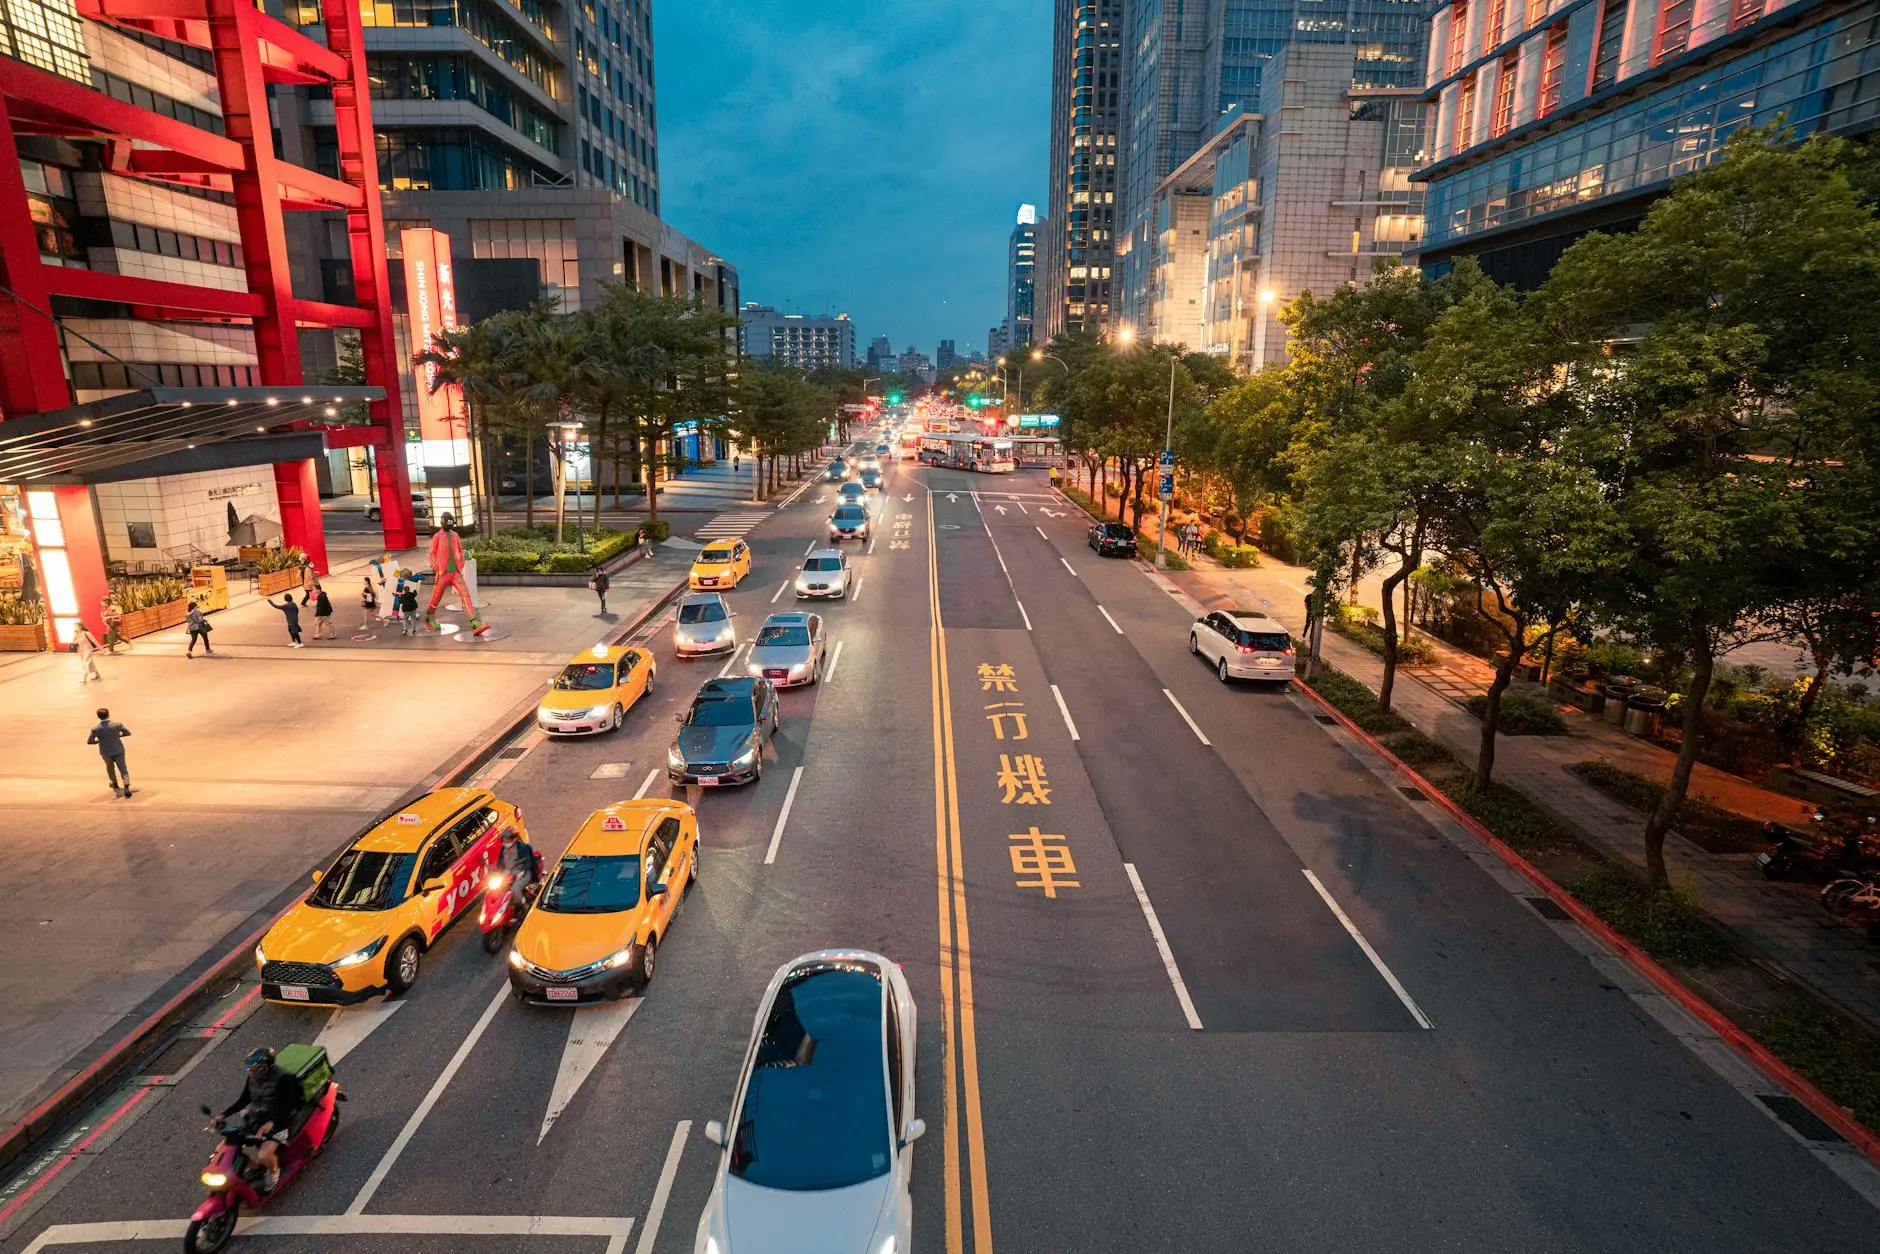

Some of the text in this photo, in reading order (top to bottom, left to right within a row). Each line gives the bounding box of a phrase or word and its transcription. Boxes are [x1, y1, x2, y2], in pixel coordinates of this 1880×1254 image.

[416, 260, 427, 288] SHIN
[418, 293, 430, 324] KONG
[977, 663, 1080, 899] 禁行機車
[446, 850, 489, 916] yoxi
